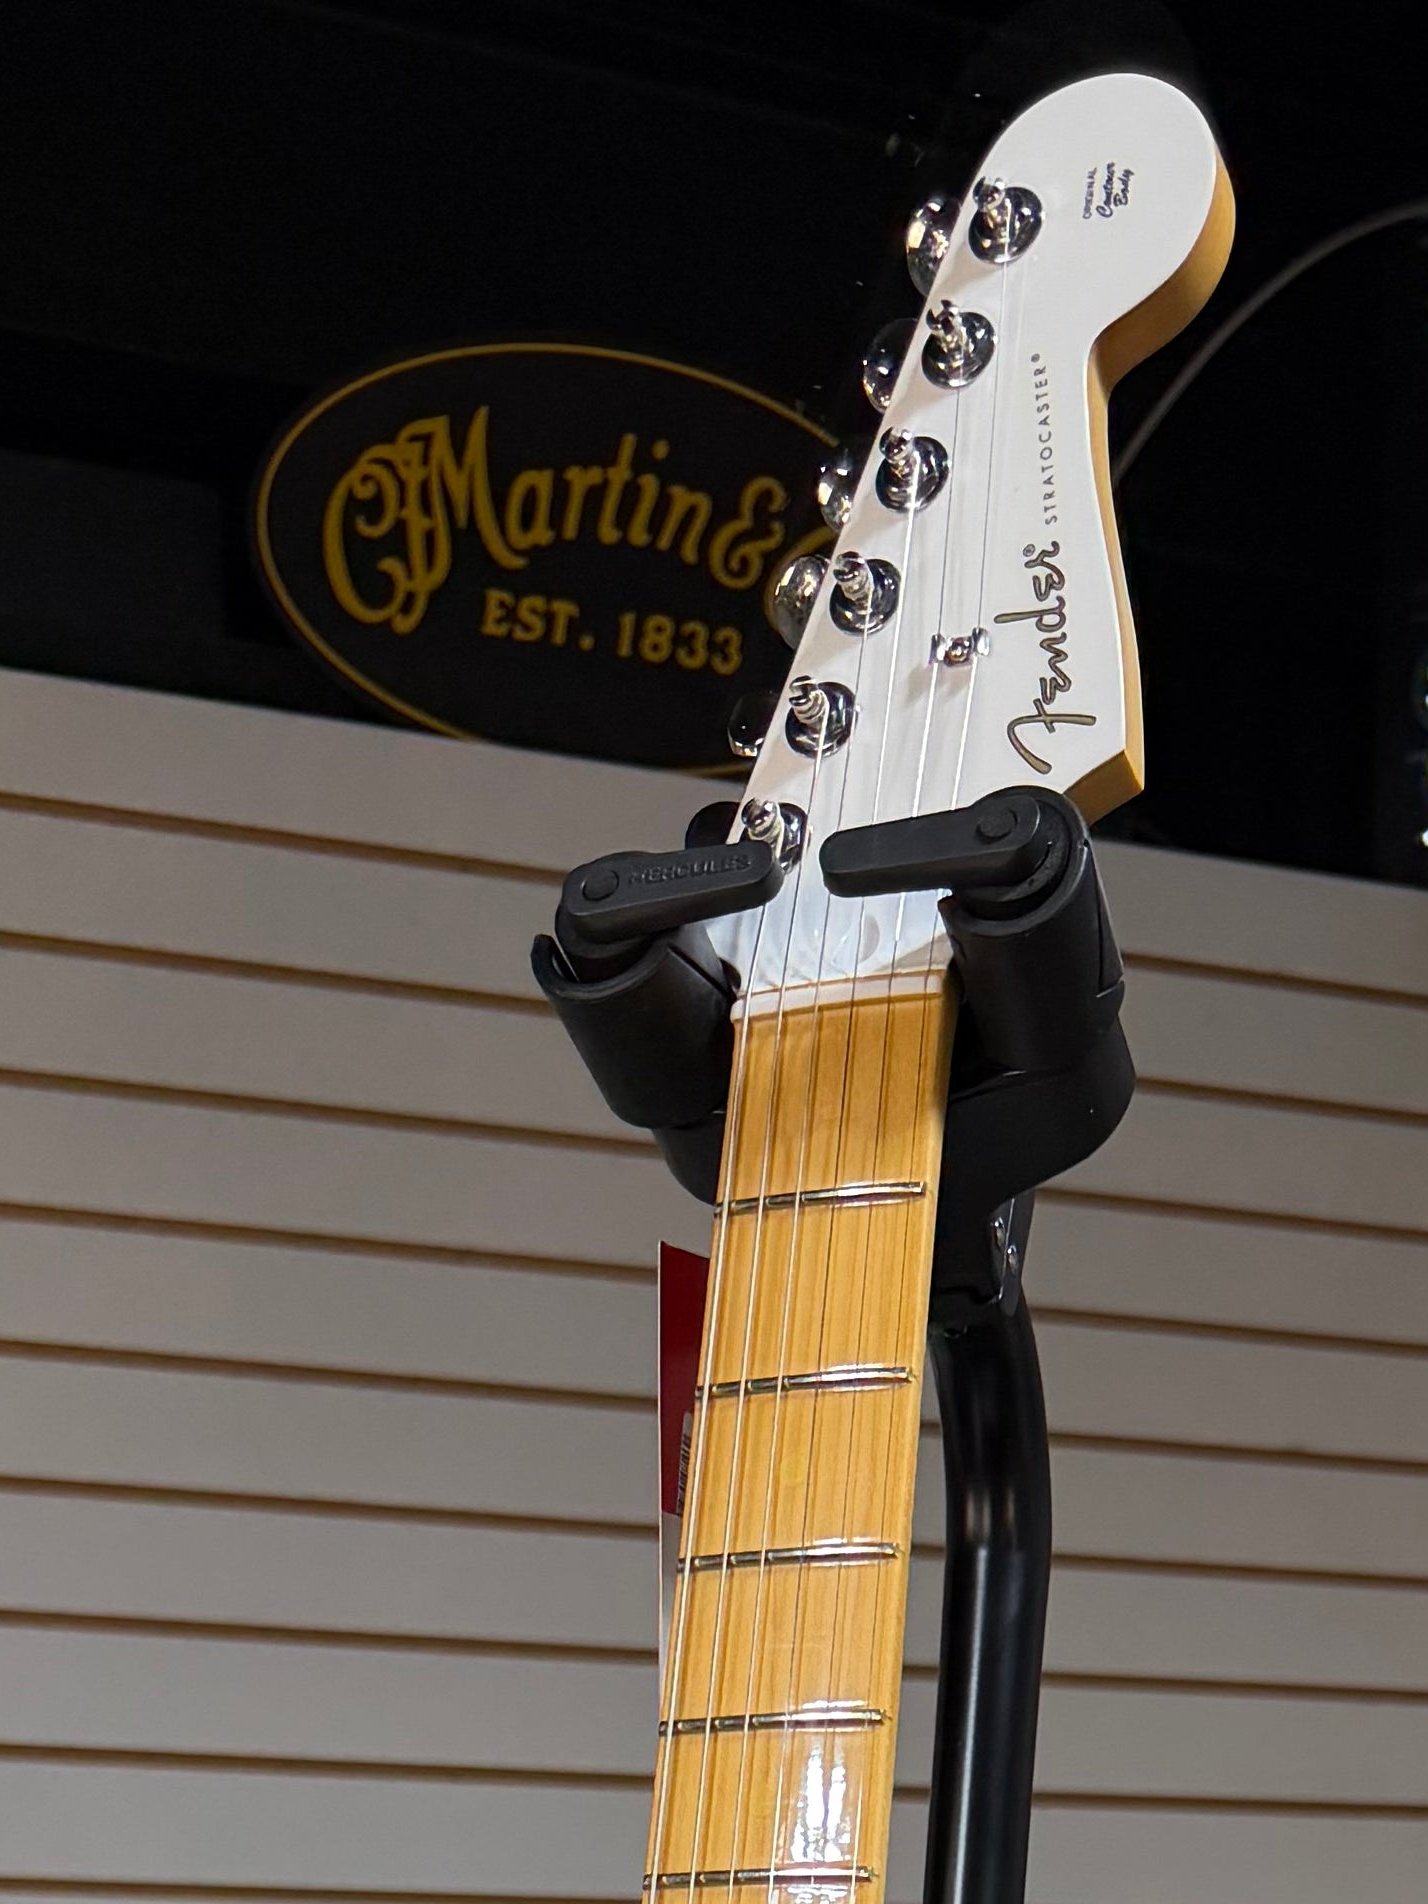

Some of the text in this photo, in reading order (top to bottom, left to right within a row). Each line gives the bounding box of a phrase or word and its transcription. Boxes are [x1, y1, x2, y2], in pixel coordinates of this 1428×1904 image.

[1033, 367, 1060, 527] STRATOCASTER
[479, 586, 744, 677] EST. 1833
[993, 540, 1098, 776] Fender
[628, 854, 752, 885] HERCULES
